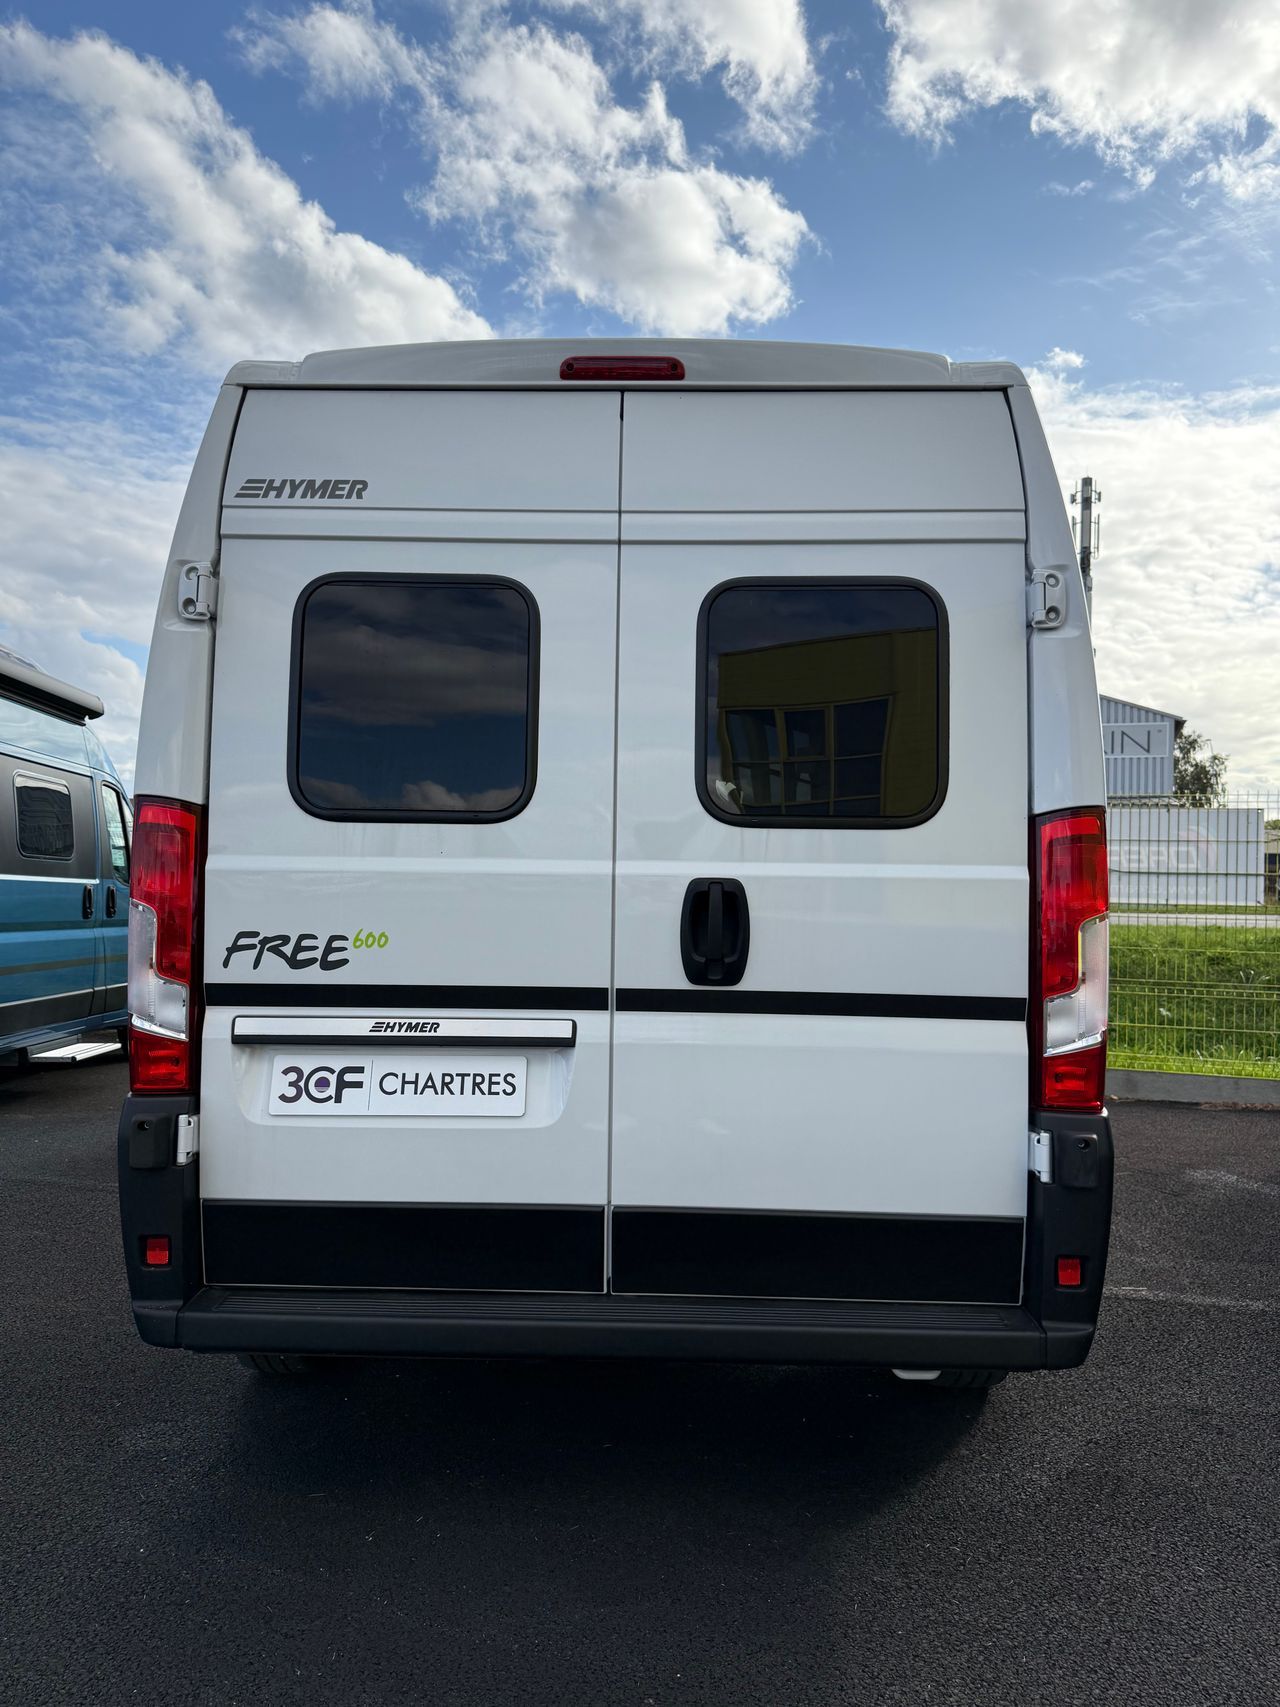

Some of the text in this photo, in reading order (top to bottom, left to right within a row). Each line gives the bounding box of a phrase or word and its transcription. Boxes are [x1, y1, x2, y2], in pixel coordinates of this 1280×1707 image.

[257, 479, 368, 499] HYMER
[1104, 730, 1151, 754] IN
[222, 928, 389, 971] FREE 600
[381, 1022, 440, 1033] HYMER
[278, 1066, 517, 1104] 3CF CHARTRES
